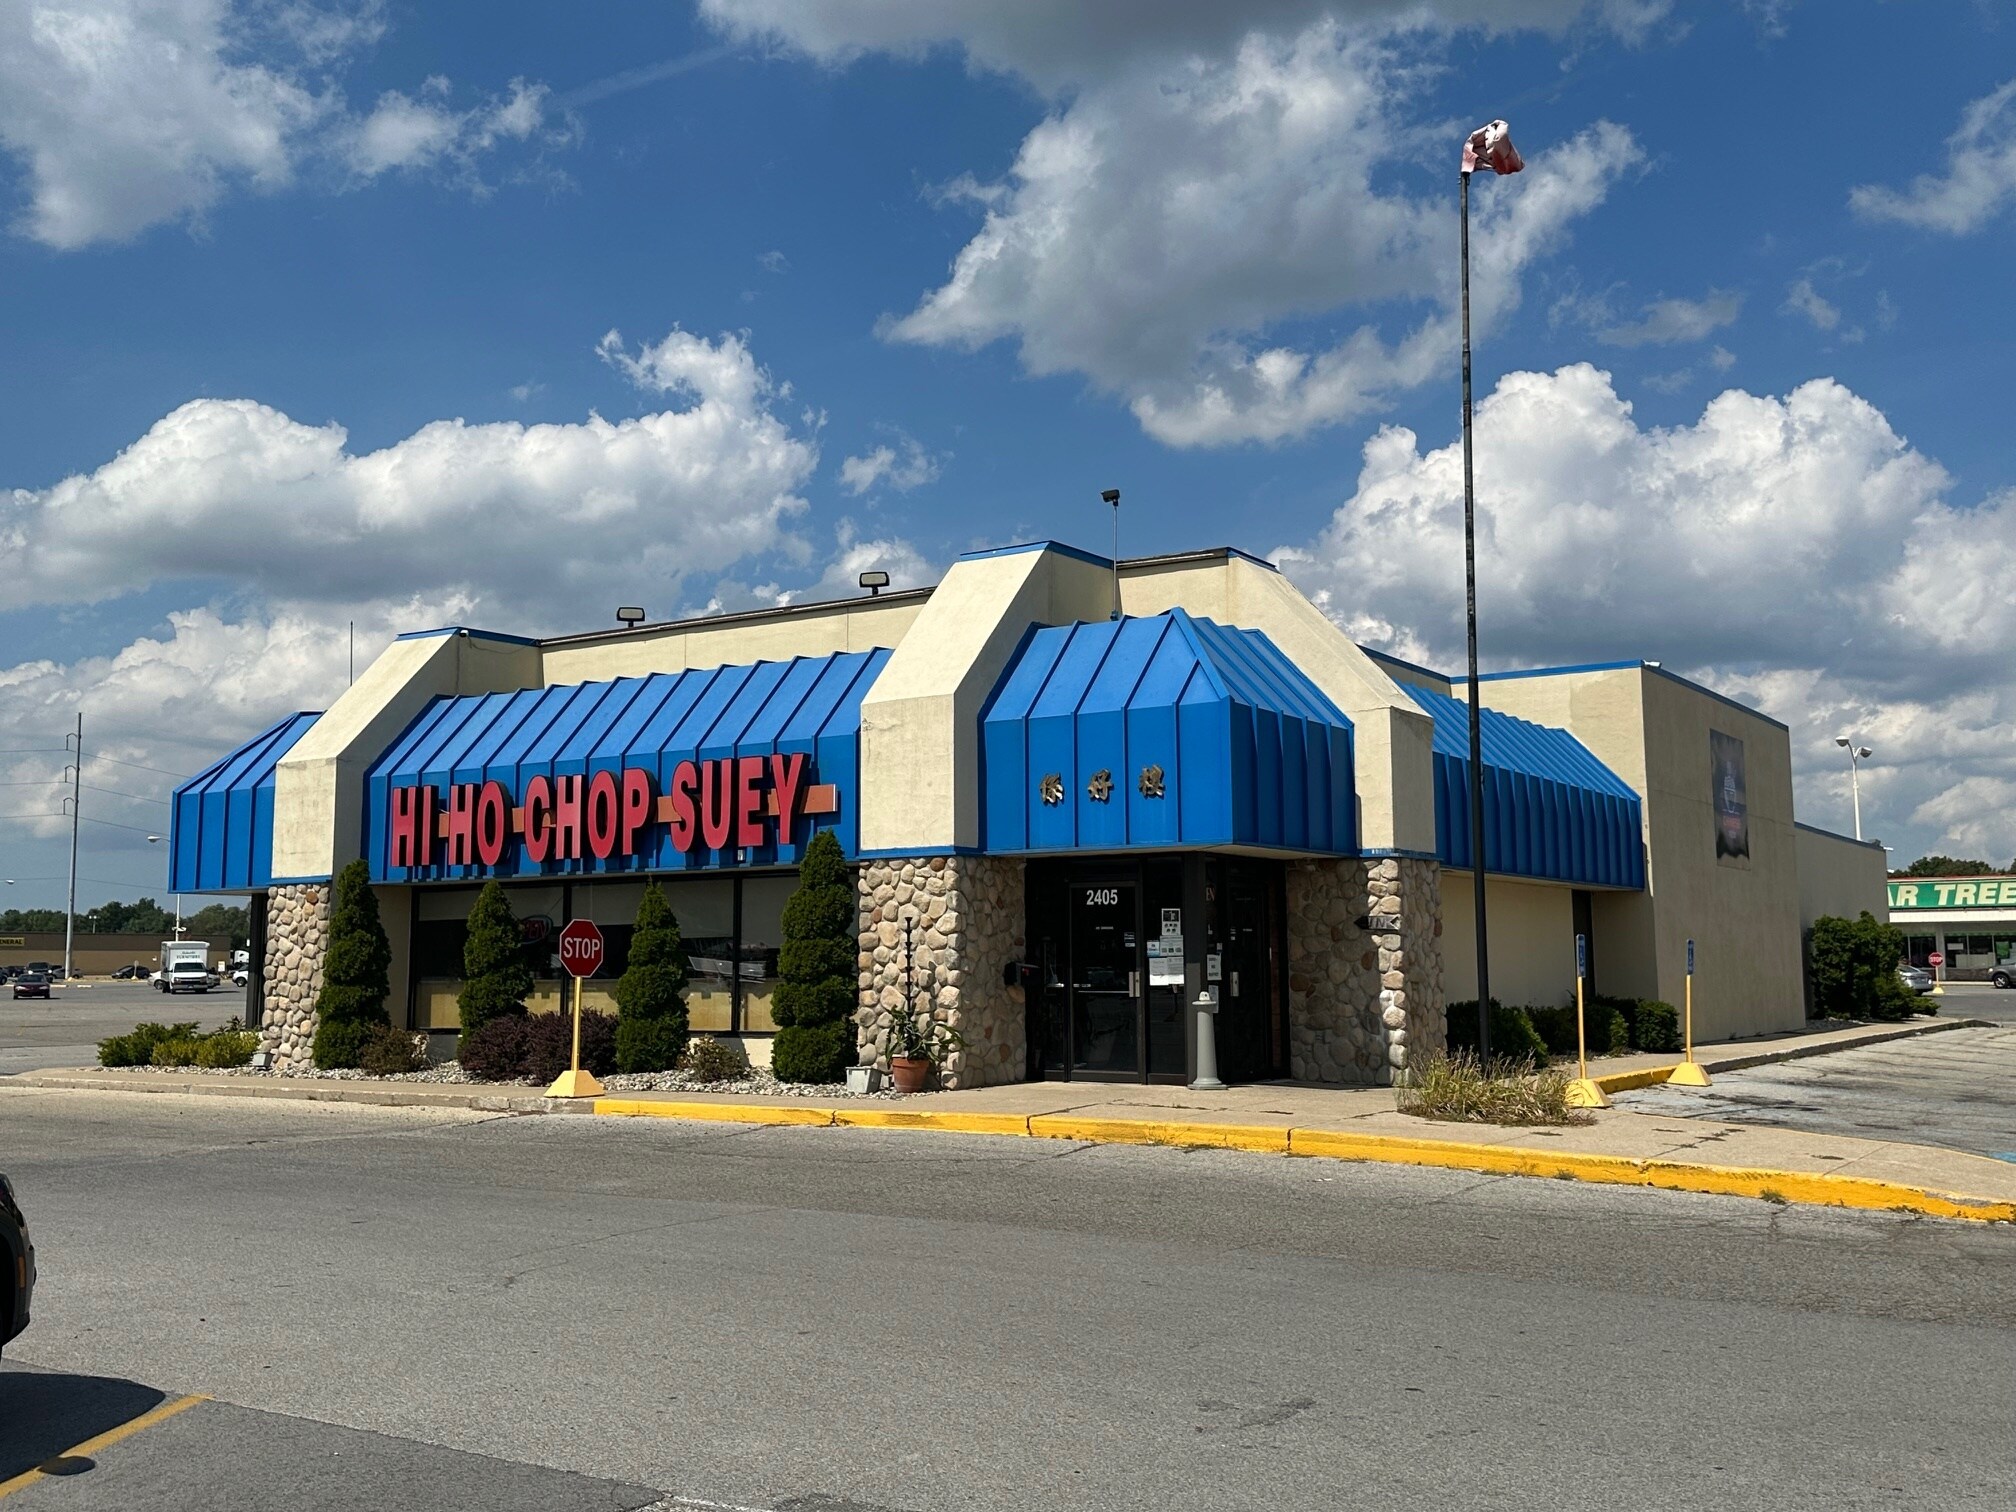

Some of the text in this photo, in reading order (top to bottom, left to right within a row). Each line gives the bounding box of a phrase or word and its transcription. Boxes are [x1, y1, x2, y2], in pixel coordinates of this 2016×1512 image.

[524, 767, 651, 863] CHOP
[670, 752, 805, 853] SUEY
[1086, 889, 1118, 905] 2405
[1934, 882, 2016, 906] TREE
[563, 937, 600, 959] STOP
